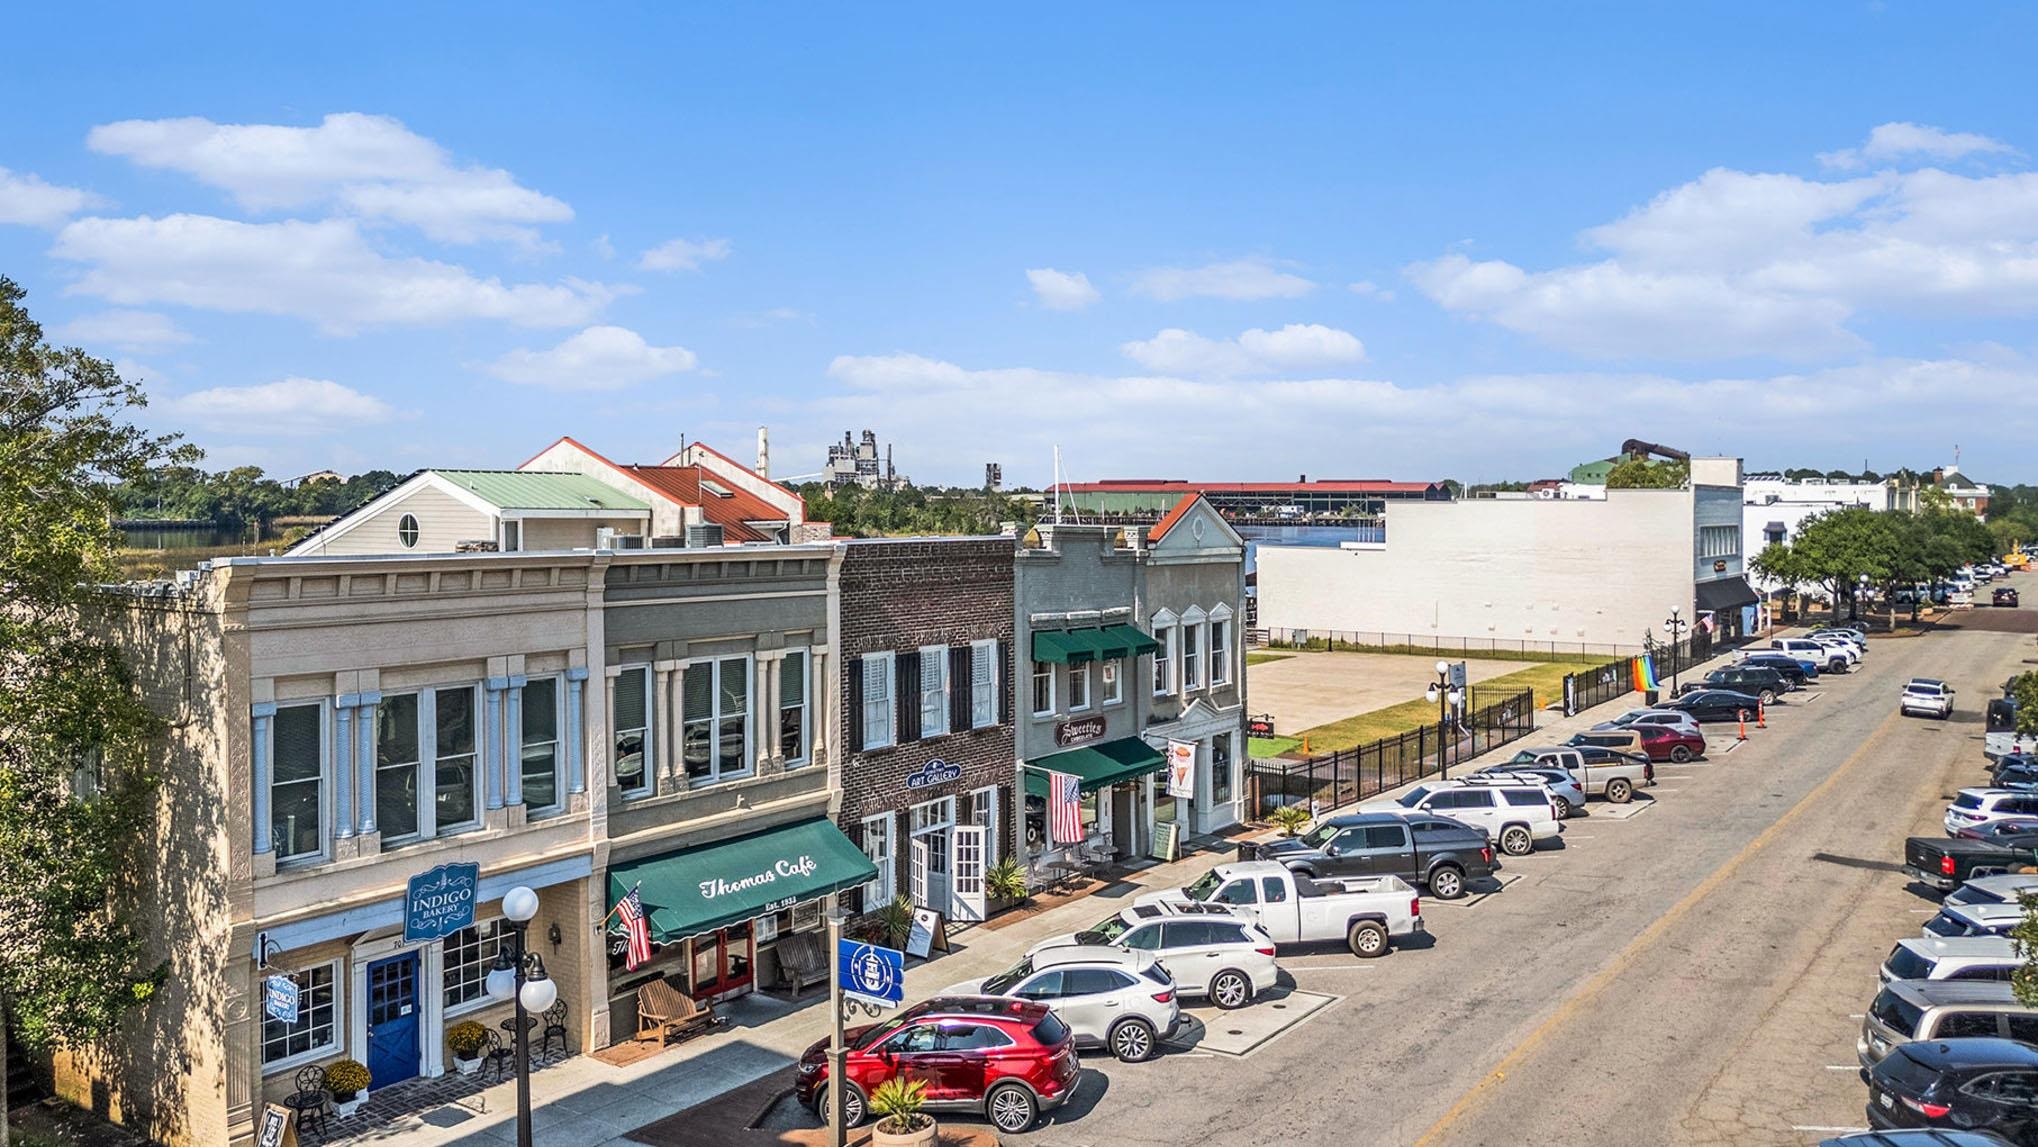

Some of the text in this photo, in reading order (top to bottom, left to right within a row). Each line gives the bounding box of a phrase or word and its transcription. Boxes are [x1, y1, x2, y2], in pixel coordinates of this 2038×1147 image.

[911, 776, 925, 786] ART
[927, 769, 958, 784] GALLERY
[699, 855, 817, 899] Thomas Café
[413, 888, 471, 912] INDIGO
[423, 904, 458, 919] BAKERY
